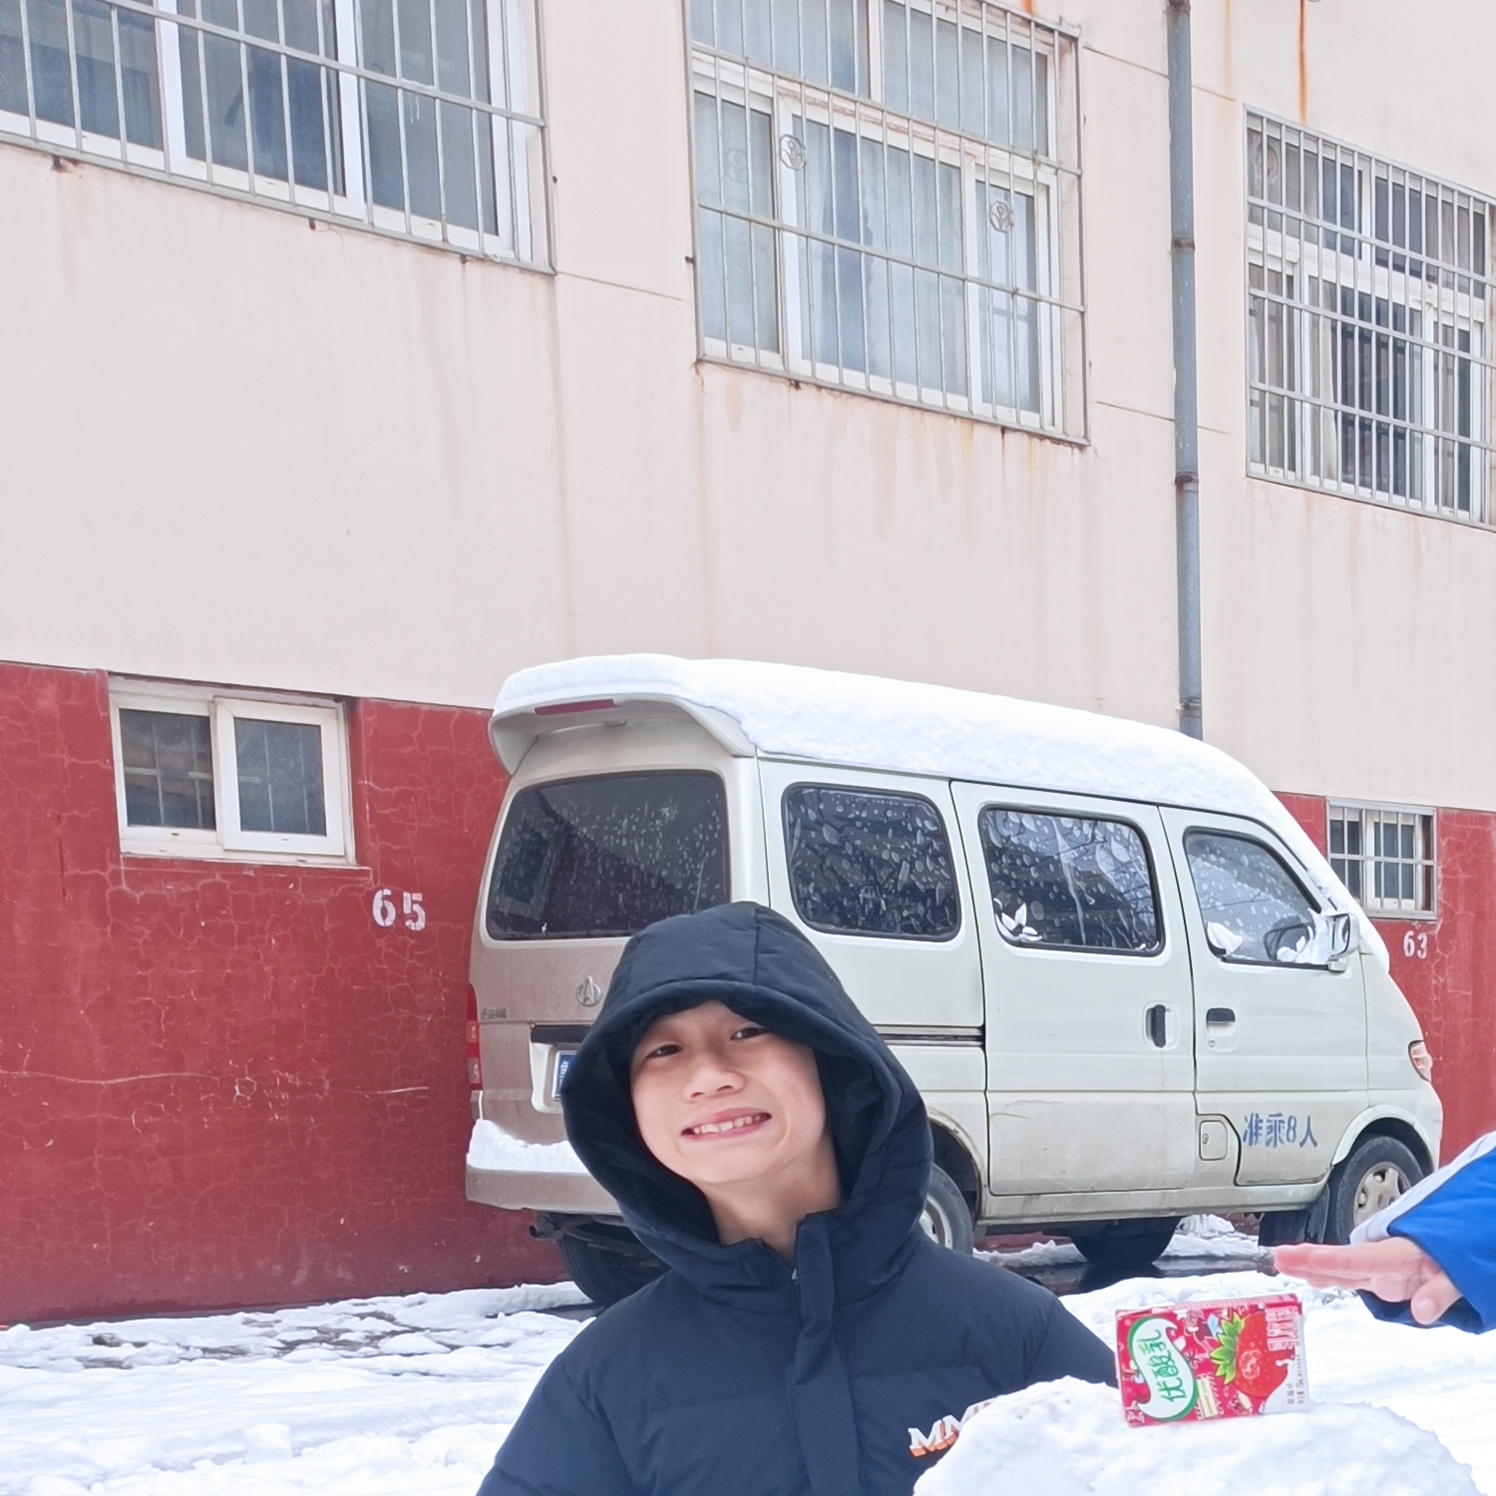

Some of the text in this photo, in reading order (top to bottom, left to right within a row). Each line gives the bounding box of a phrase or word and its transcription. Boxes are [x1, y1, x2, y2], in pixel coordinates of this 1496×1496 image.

[373, 888, 426, 931] 65
[1403, 930, 1428, 959] 63
[1243, 1112, 1318, 1148] 准乘8人
[1137, 1328, 1187, 1402] 优酸乳
